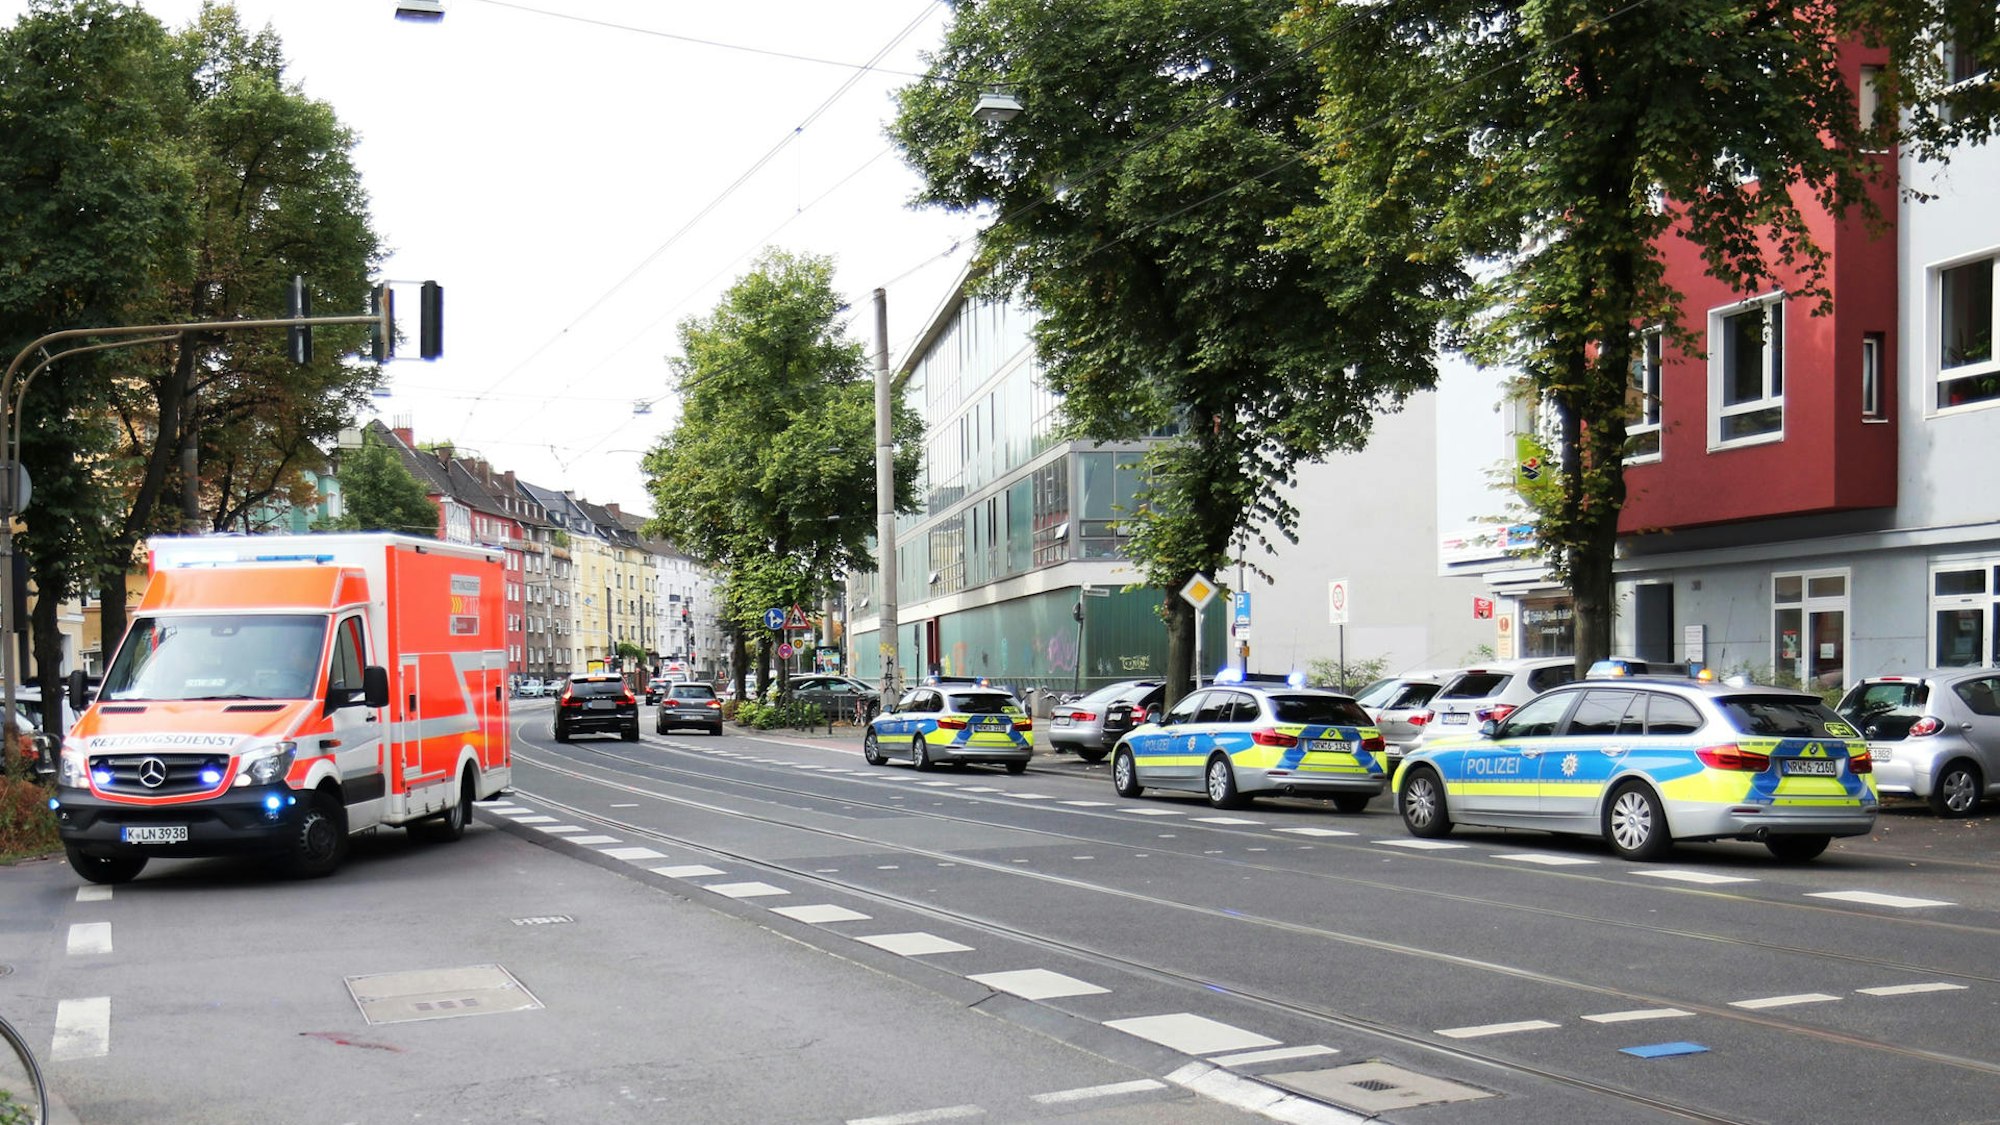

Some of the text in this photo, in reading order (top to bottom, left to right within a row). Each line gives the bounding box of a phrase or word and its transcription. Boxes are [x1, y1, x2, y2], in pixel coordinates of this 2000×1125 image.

[89, 734, 239, 748] RETTUNGSDIENST
[1145, 738, 1170, 751] POLIZEI
[1467, 757, 1521, 775] POLIZEI
[158, 827, 187, 840] 3938
